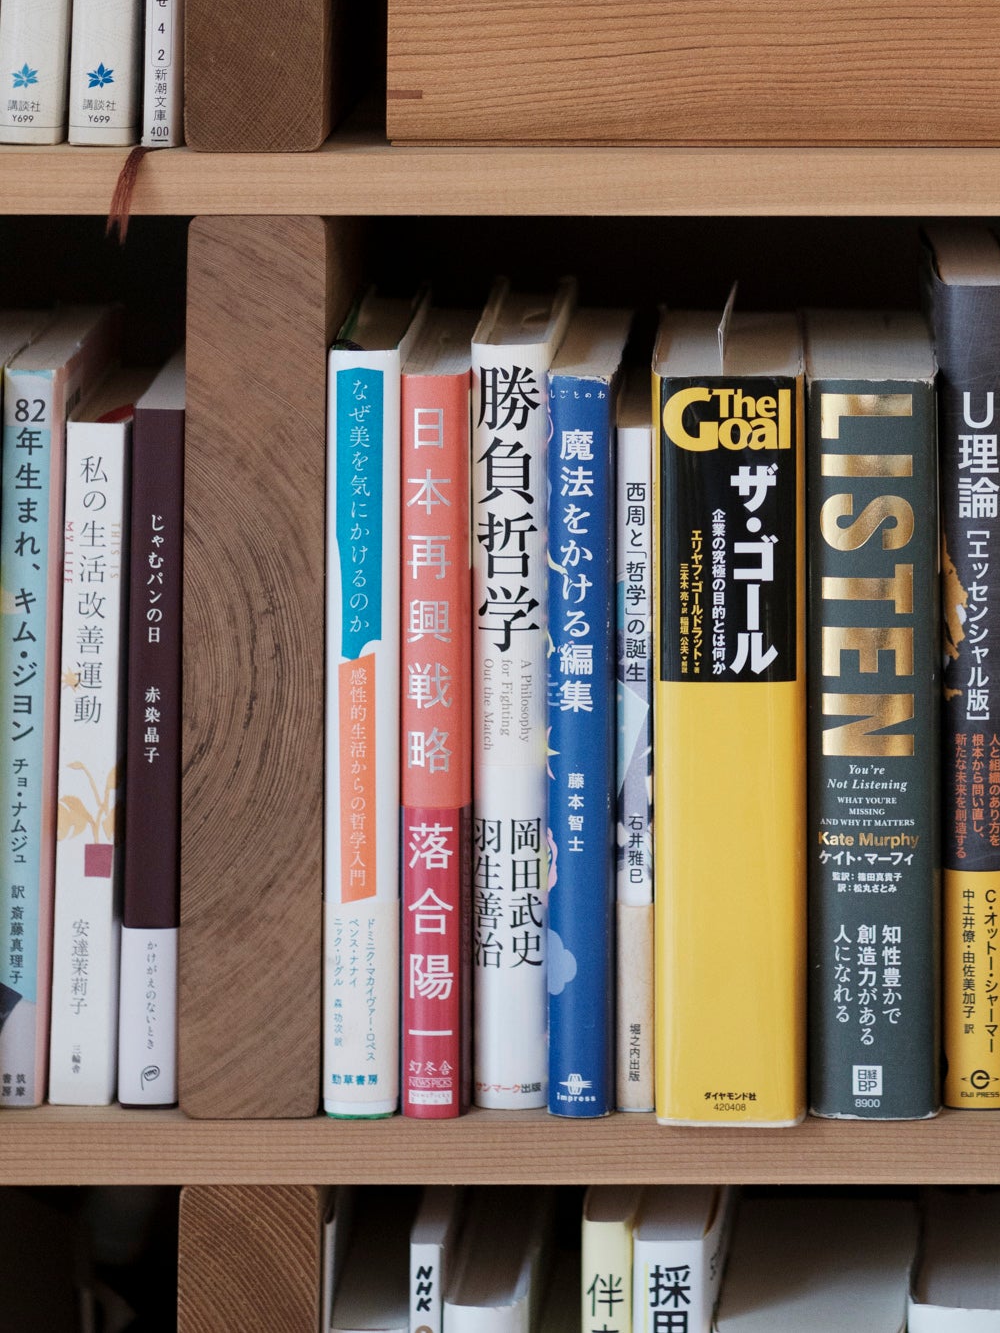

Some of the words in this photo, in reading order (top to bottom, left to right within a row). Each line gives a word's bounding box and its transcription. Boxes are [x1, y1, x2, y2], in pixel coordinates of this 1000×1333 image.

[157, 23, 165, 34] 4
[157, 50, 165, 61] 2
[7, 99, 40, 112] 講談社
[82, 99, 116, 112] 講談社
[153, 69, 168, 120] 新潮文庫
[150, 126, 169, 138] 400
[663, 386, 791, 451] Goal
[706, 388, 777, 419] The
[957, 391, 1000, 519] U理論
[348, 378, 371, 634] なぜ美を気にかけるのか
[477, 365, 541, 653] 勝負哲学
[11, 398, 47, 742] 82年生まれ、キム・ジヨン
[74, 455, 109, 724] 私の生活改善運動
[146, 514, 165, 644] じゃむパンの日
[406, 408, 452, 775] 日本再興戦略
[559, 429, 594, 713] 魔法をかける編集
[625, 482, 647, 684] 西周と「哲学」の誕生
[711, 508, 727, 675] 企業の究極の目的とは何か
[729, 462, 779, 675] ザ・ゴール
[819, 393, 915, 757] LISTEN
[483, 658, 494, 680] Out
[501, 659, 513, 677] for
[144, 686, 163, 763] 赤染晶子
[483, 687, 494, 706] the
[499, 682, 513, 736] Fighting
[518, 675, 532, 743] Philosophy
[483, 712, 494, 750] Match
[349, 668, 368, 887] 感性的生活からの哲学入門
[826, 778, 847, 789] Not
[852, 778, 908, 792] Listening
[848, 764, 886, 775] You're
[954, 733, 968, 859] 新たな未来を創造する
[971, 733, 985, 839] 根本から問い直し、
[987, 733, 1000, 847] 人と組織のあり方を
[10, 758, 29, 864] チョ・ナムジュ
[567, 773, 585, 852] 藤本智士
[820, 818, 839, 826] AND
[840, 819, 861, 827] WHY
[863, 819, 873, 827] IT
[874, 819, 915, 827] MATTERS
[837, 797, 863, 805] WHAT
[865, 797, 898, 805] YOU'RE
[848, 808, 886, 816] MISSING
[818, 831, 855, 847] Kate
[858, 832, 919, 849] Murphy
[818, 851, 914, 866] ケイト・マーフィ
[11, 885, 25, 899] 訳
[474, 817, 503, 970] 羽生善治
[507, 816, 545, 971] 岡田武史
[408, 822, 454, 1037] 落合陽一
[962, 889, 977, 1019] 中土井僚・由佐美加子
[833, 925, 853, 1024] 人になれる
[856, 924, 877, 1045] 創造力がある
[881, 924, 901, 1025] 知性豊かで
[628, 1023, 641, 1082] 堀之内出版
[963, 1024, 975, 1035] 訳
[331, 1074, 378, 1085] 勁草書房
[408, 1060, 453, 1075] 幻冬舎
[857, 1069, 877, 1081] 日経
[857, 1081, 877, 1092] BP
[556, 1092, 597, 1104] impress
[703, 1091, 757, 1102] ダイヤモンド社
[713, 1102, 747, 1112] 420408
[854, 1098, 881, 1108] 8900
[415, 1266, 434, 1313] NHK
[586, 1273, 625, 1333] 伴
